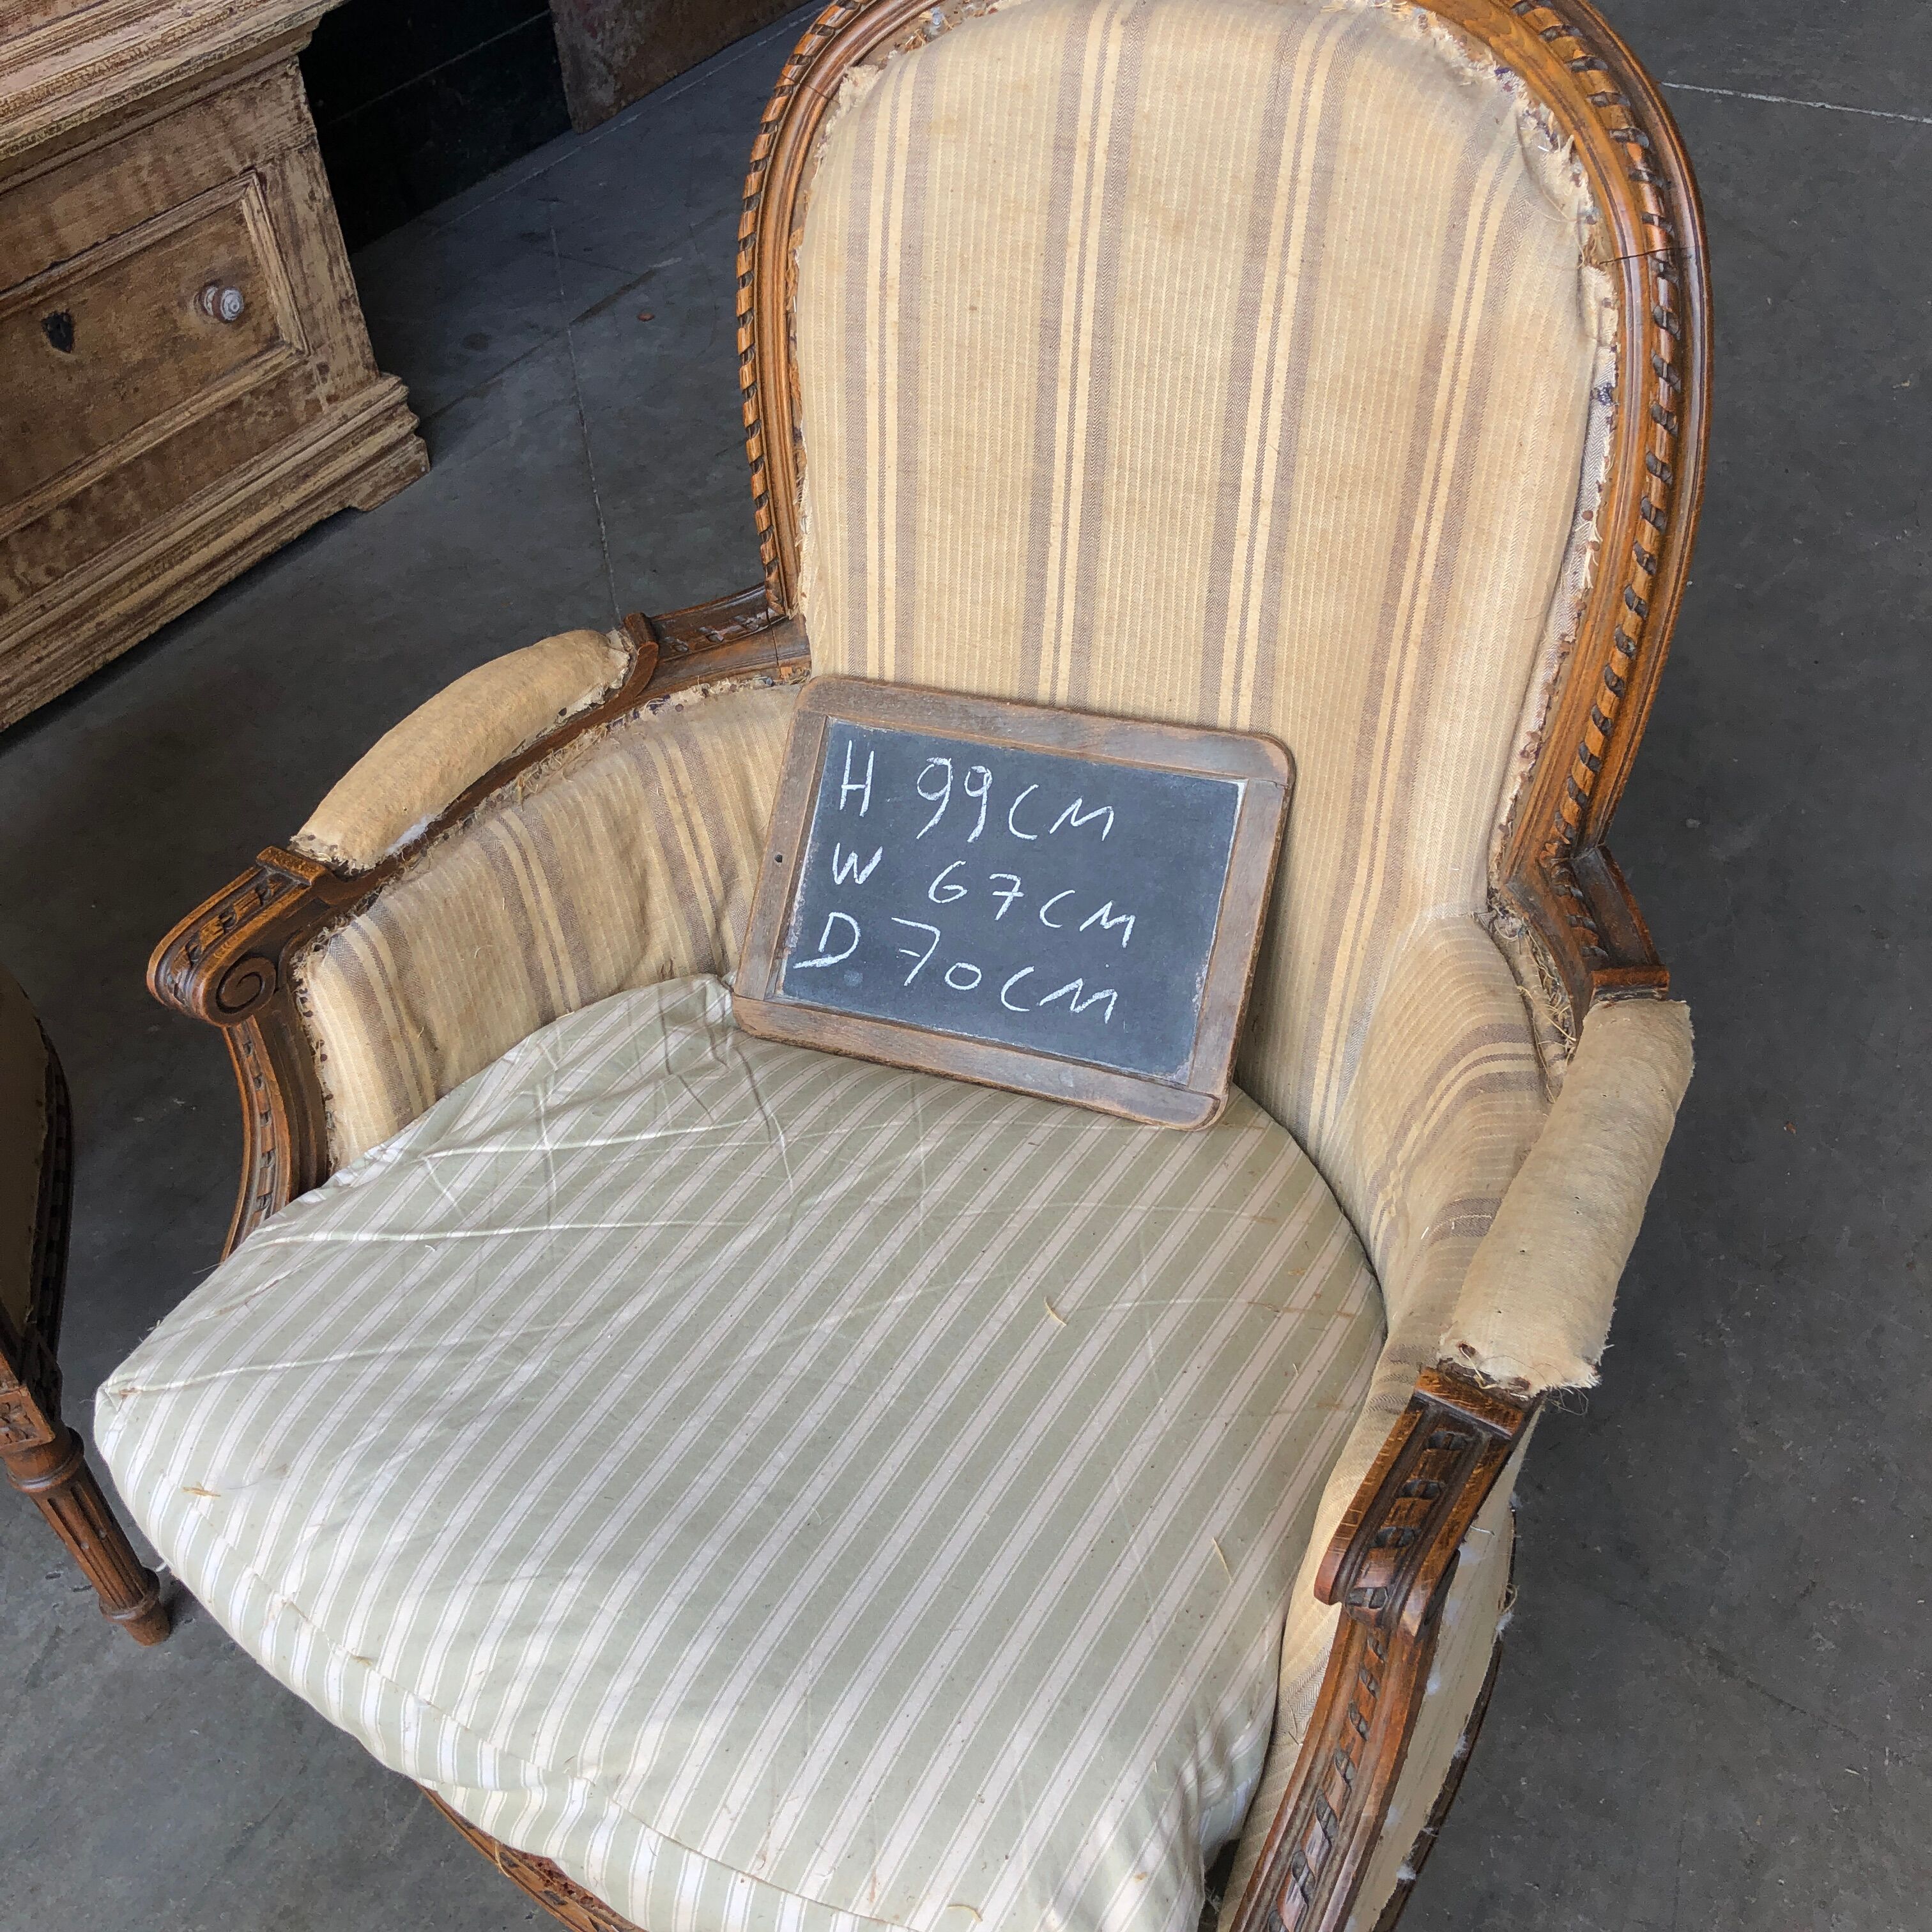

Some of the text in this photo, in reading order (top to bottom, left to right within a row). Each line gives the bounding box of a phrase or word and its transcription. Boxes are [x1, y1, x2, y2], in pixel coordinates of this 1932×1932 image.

[839, 739, 874, 817] H
[832, 841, 883, 885] W
[793, 911, 861, 970] D
